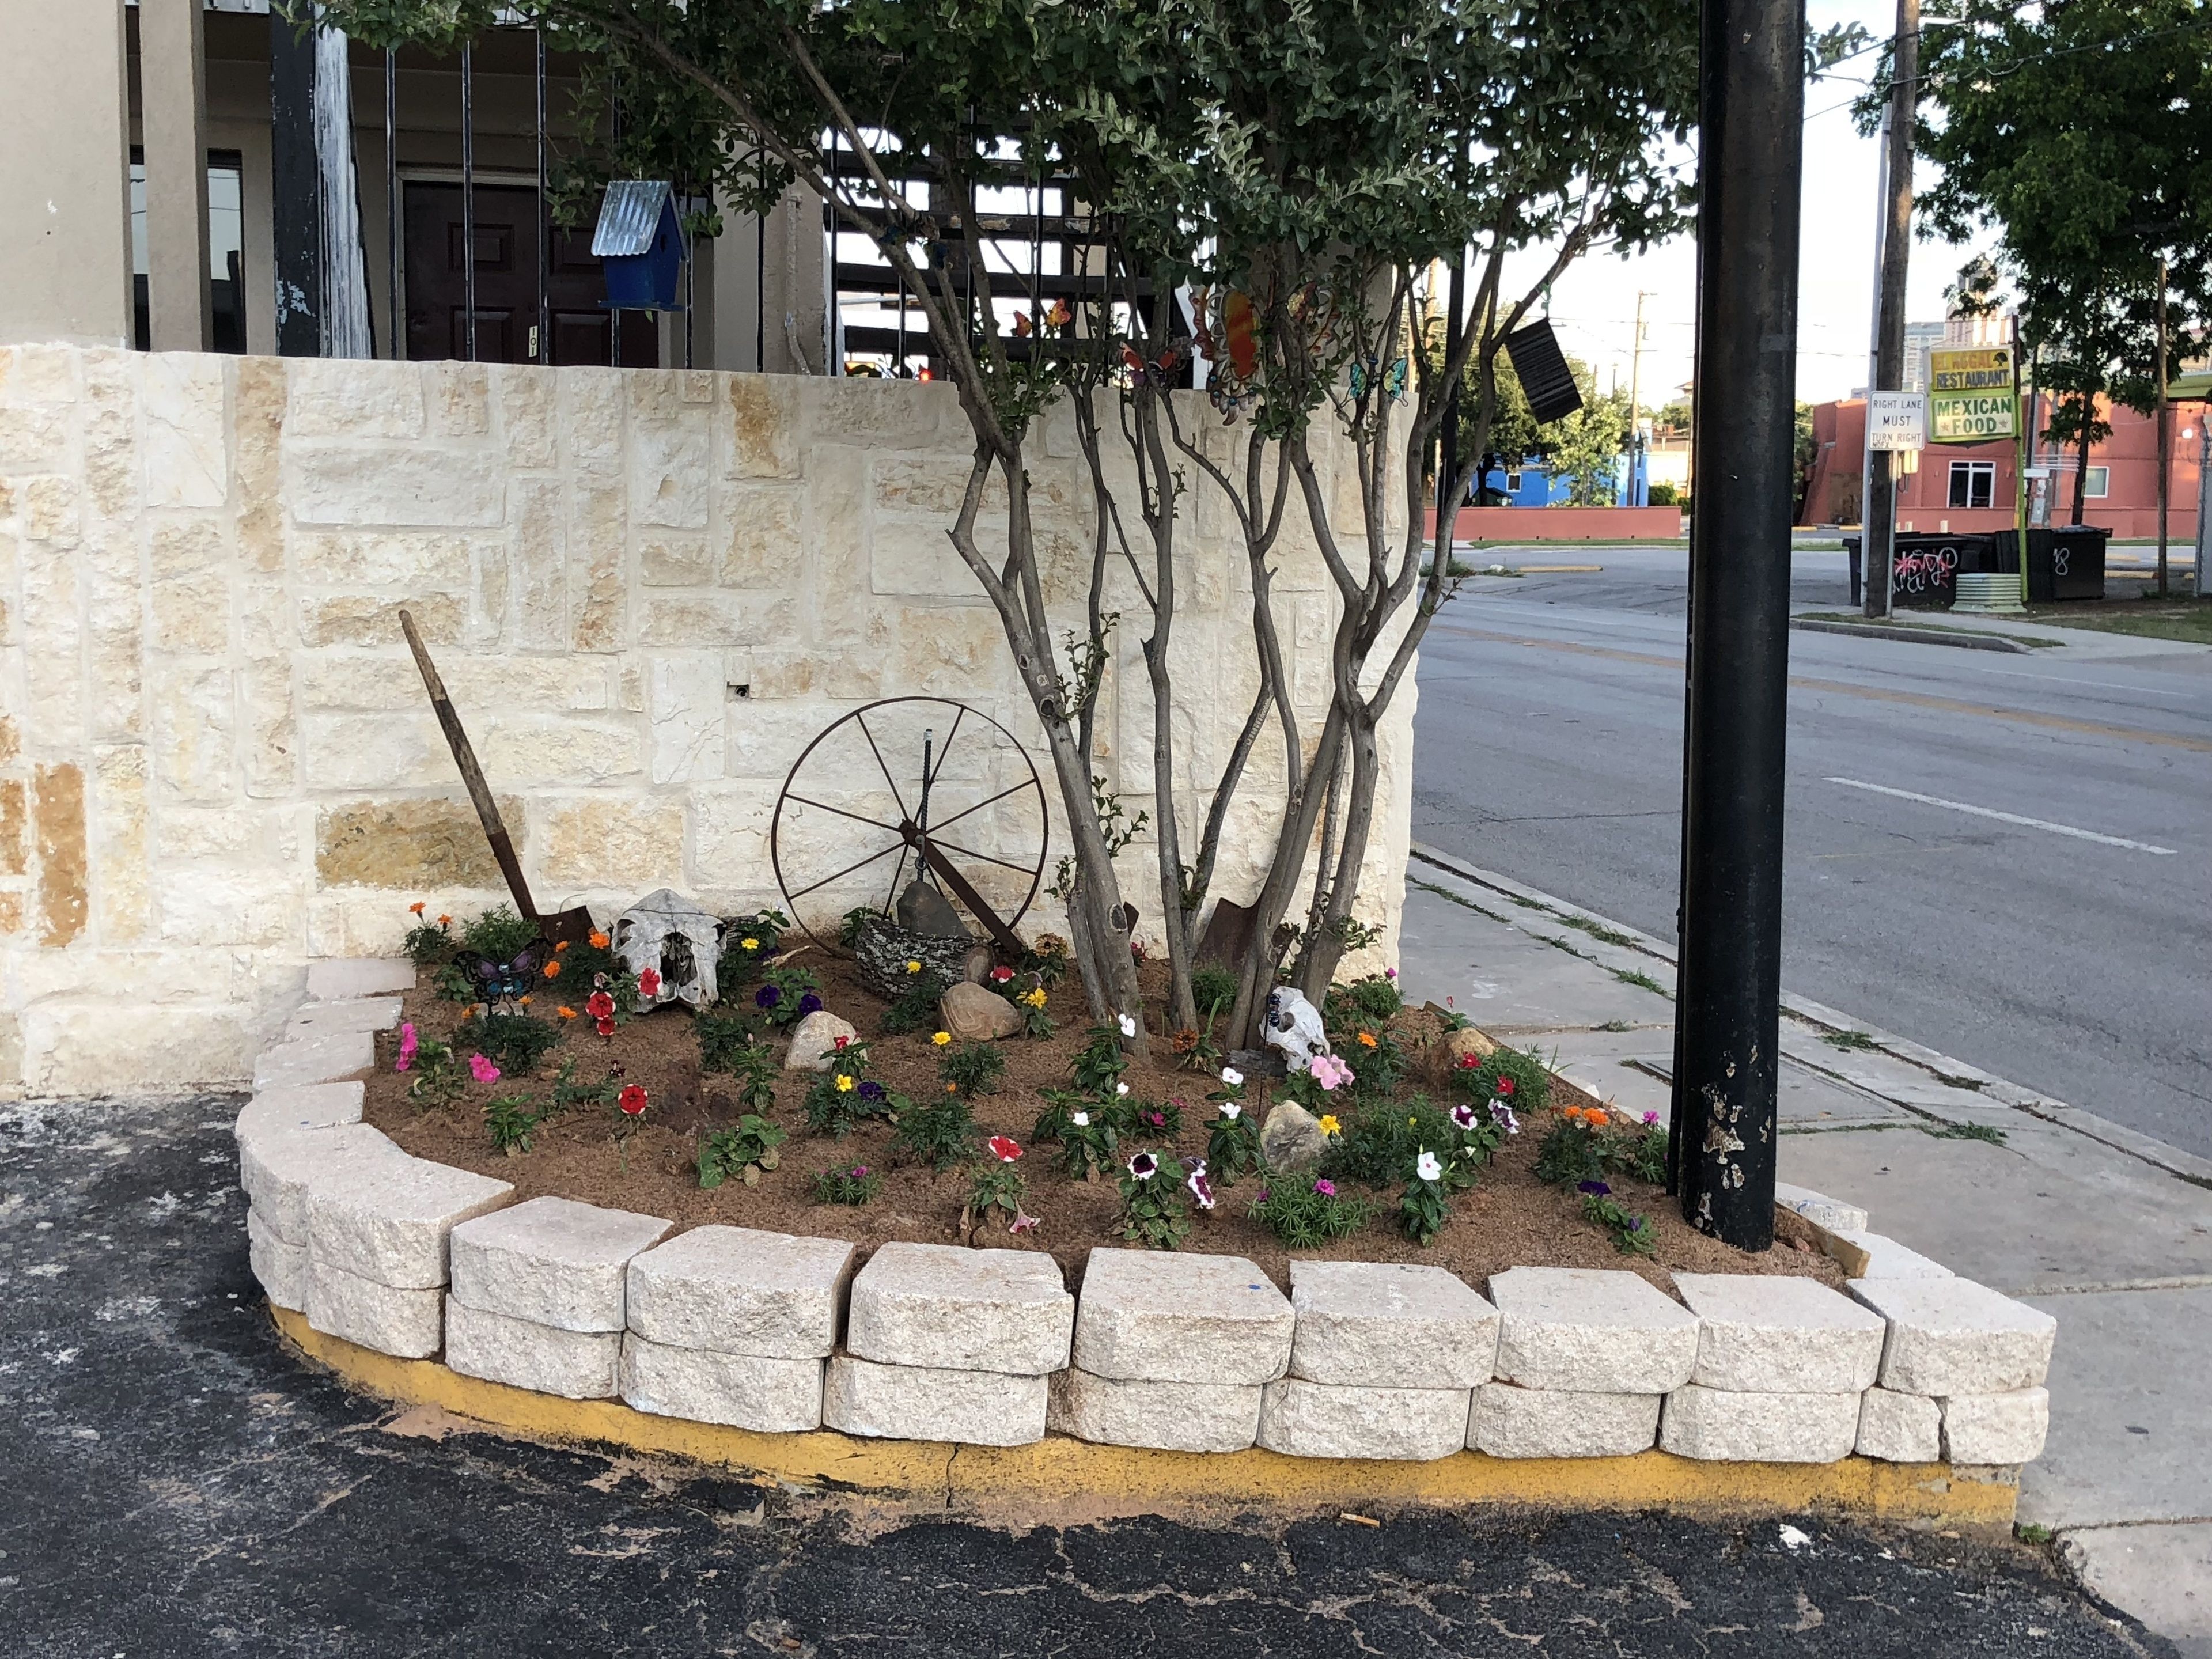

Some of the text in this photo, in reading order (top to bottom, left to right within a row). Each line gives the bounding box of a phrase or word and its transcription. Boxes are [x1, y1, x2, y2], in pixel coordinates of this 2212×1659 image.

[1937, 369, 2009, 388] RESTAURANT
[1873, 400, 1922, 408] RIGHT LANE
[1937, 397, 2012, 416] MEXICAN
[1883, 416, 1911, 426] MUST
[1952, 417, 1997, 434] FOOD
[1872, 433, 1921, 442] TURN RIGHT
